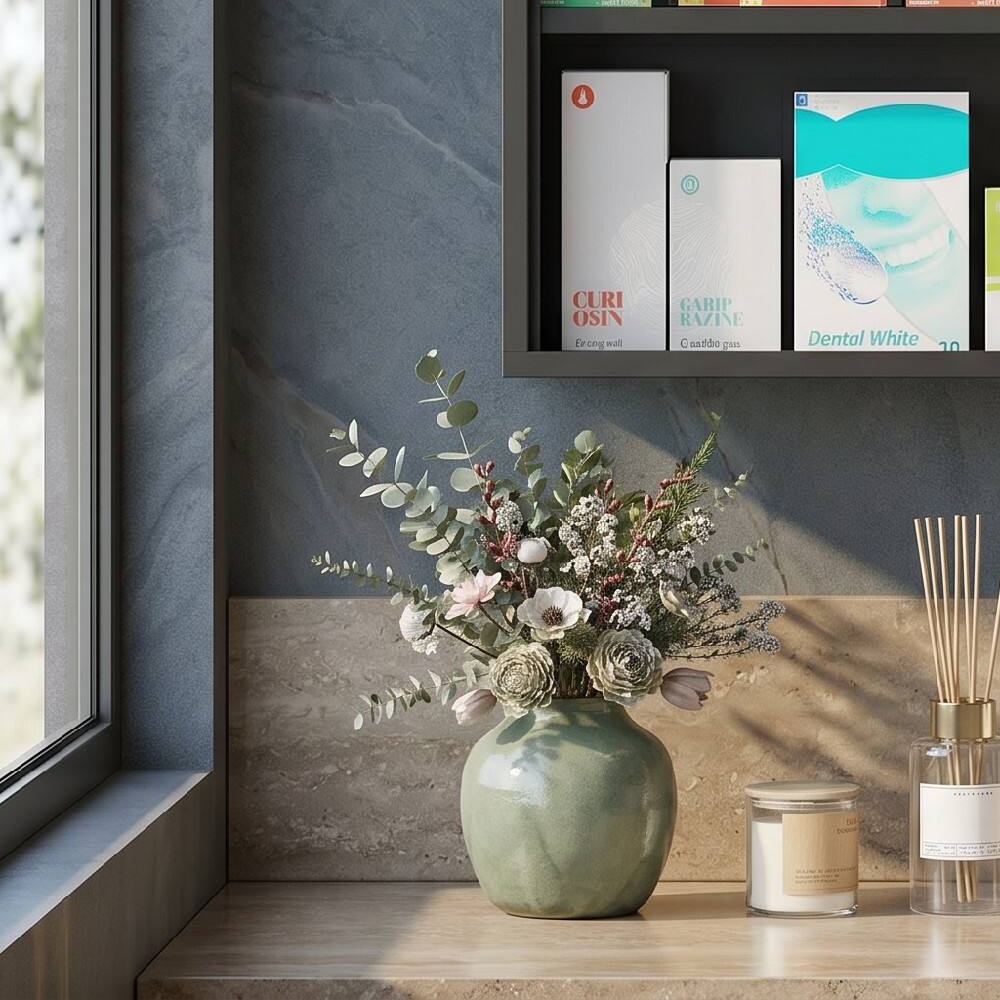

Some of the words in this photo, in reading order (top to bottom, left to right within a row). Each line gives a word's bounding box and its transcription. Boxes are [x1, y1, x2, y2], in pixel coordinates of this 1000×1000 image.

[572, 290, 623, 309] CURI
[572, 310, 623, 327] OSIN
[808, 329, 865, 347] Dental
[870, 330, 919, 347] White
